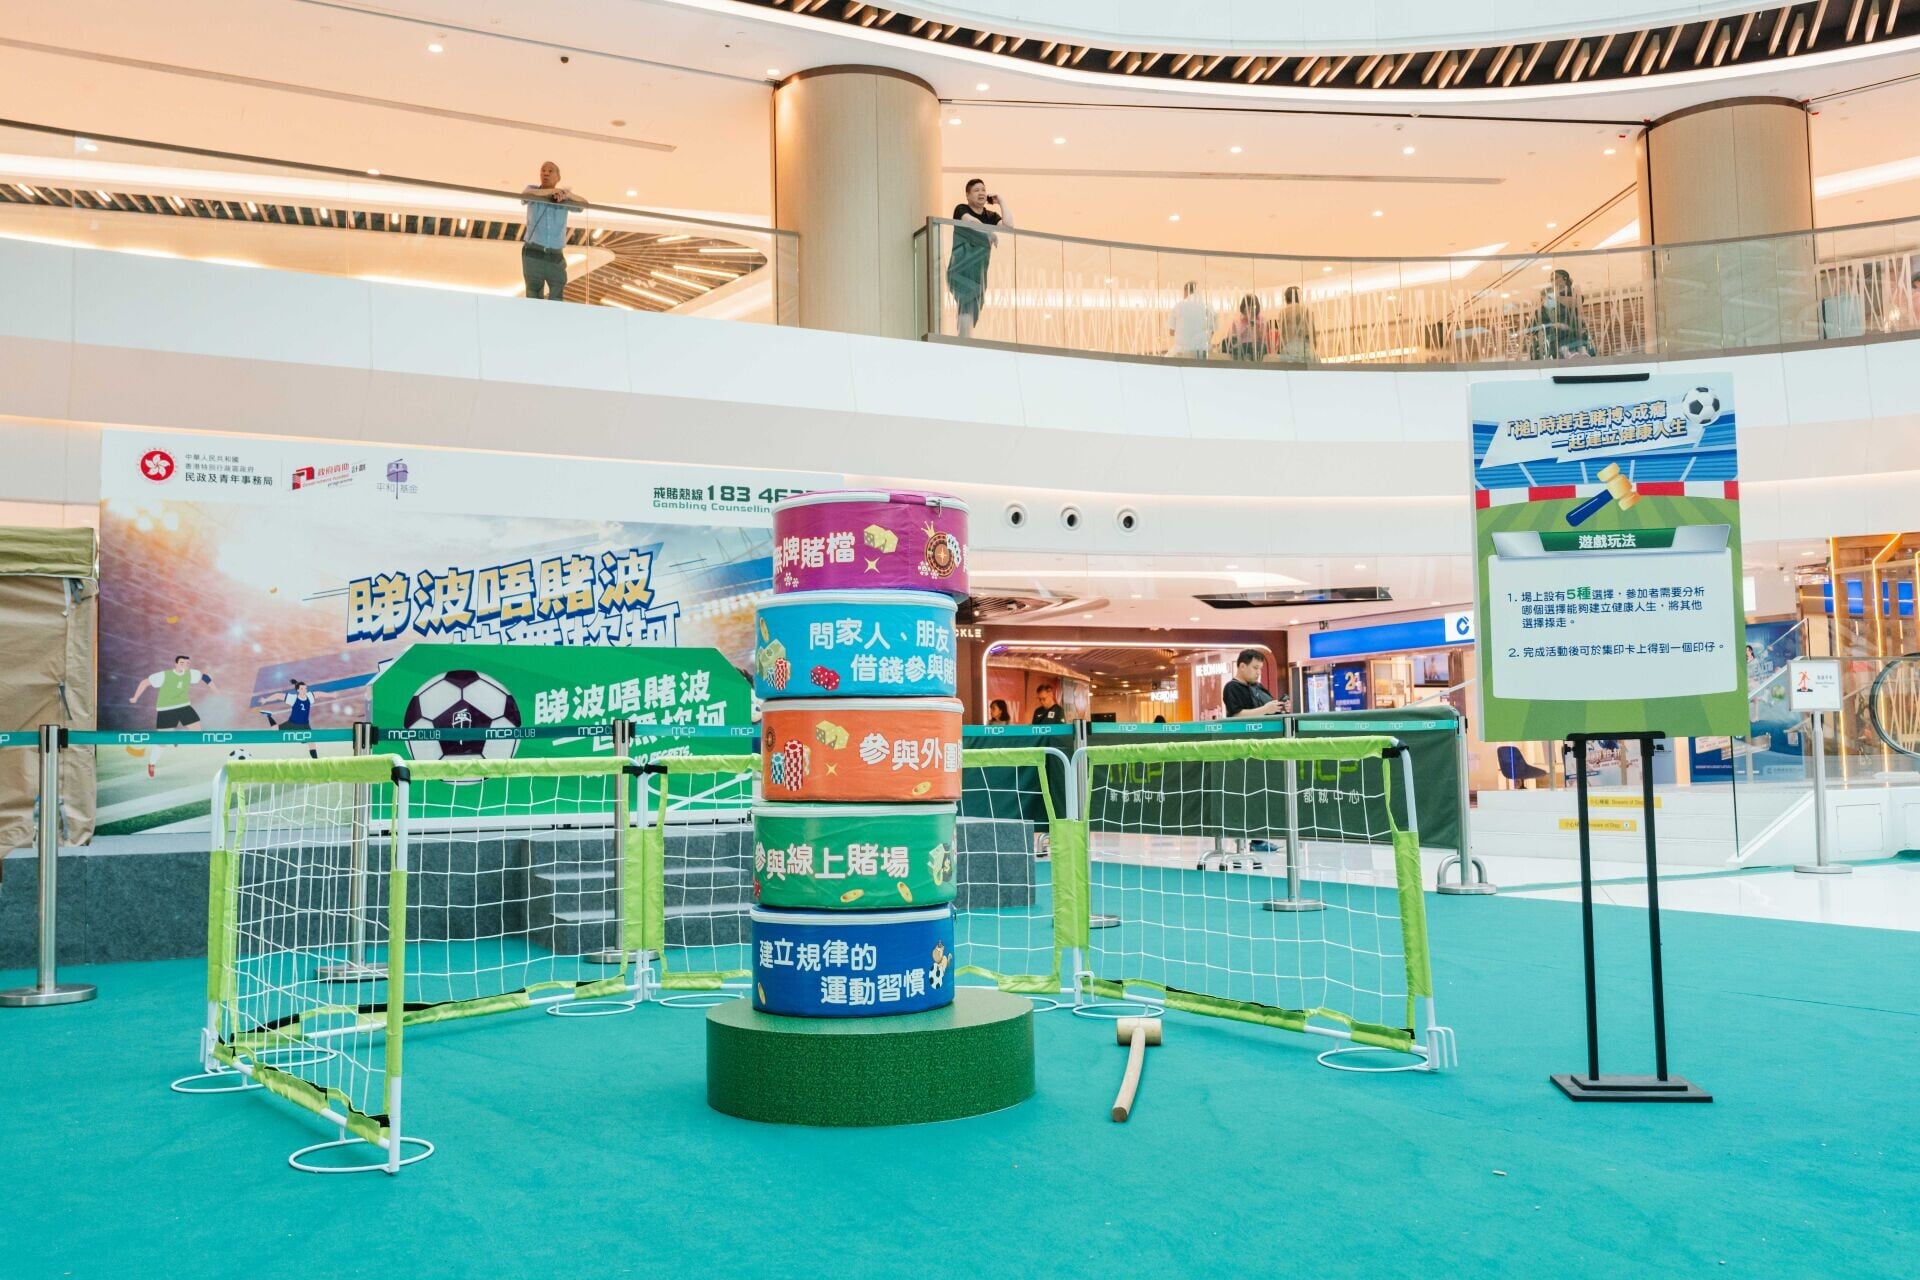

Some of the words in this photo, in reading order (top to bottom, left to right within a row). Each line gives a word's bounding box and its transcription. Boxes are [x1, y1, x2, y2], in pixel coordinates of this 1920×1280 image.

[1551, 417, 1687, 452] 一起建立健康人生
[185, 472, 273, 486] 民政及青年事務局
[653, 487, 703, 500] 戒賭熱線
[707, 485, 751, 503] 183
[653, 501, 707, 512] Gambling
[711, 503, 771, 514] Counsellin
[1578, 533, 1637, 549] 遊戲玩法
[347, 549, 656, 643] 睇波唔賭波
[809, 617, 950, 652] 問家人、朋友
[534, 670, 711, 724] 睇波唔賭波
[418, 730, 441, 740] CLUB
[514, 728, 536, 738] CLUB
[1302, 788, 1361, 805] 都城中心
[754, 841, 910, 881] 參與線上賭場
[759, 937, 877, 972] 建立規律的
[820, 967, 926, 1006] 運動習慣
